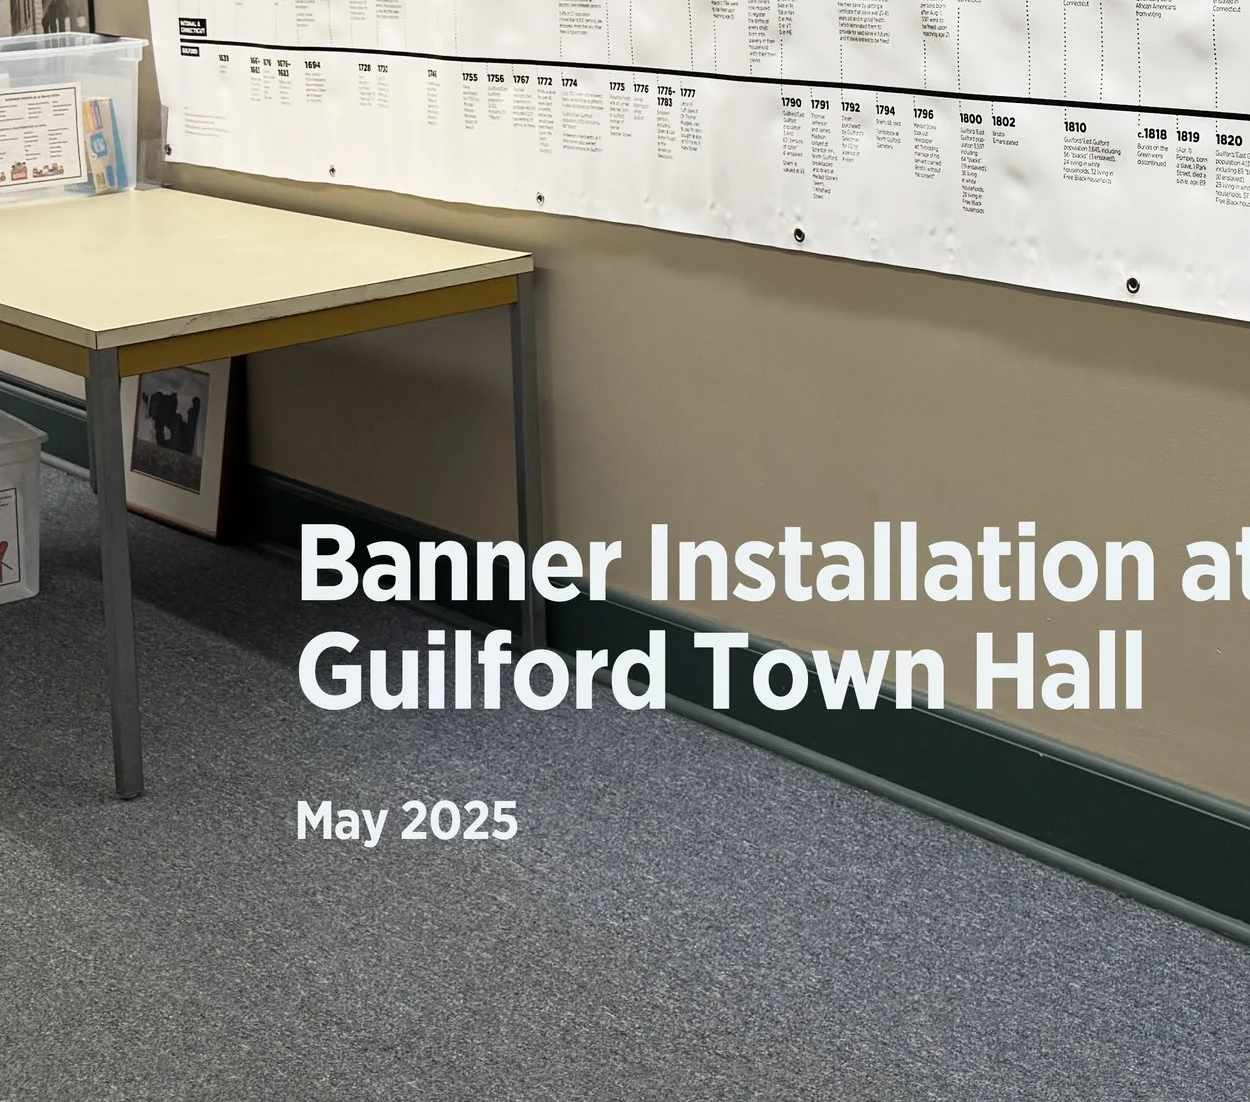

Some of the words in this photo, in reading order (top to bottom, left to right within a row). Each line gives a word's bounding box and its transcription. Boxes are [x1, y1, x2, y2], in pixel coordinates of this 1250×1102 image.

[304, 61, 321, 69] 1694
[462, 73, 478, 82] 1755
[487, 74, 504, 83] 1756
[561, 78, 578, 87] 1774
[781, 97, 802, 108] 1790
[811, 99, 829, 110] 1791
[841, 102, 860, 112] 1792
[876, 104, 895, 116] 1794
[913, 108, 934, 119] 1796
[960, 113, 982, 124] 1800
[992, 116, 1015, 127] 1802
[1064, 121, 1087, 133] 1810
[1176, 130, 1200, 143] 1819
[1216, 134, 1243, 146] 1820
